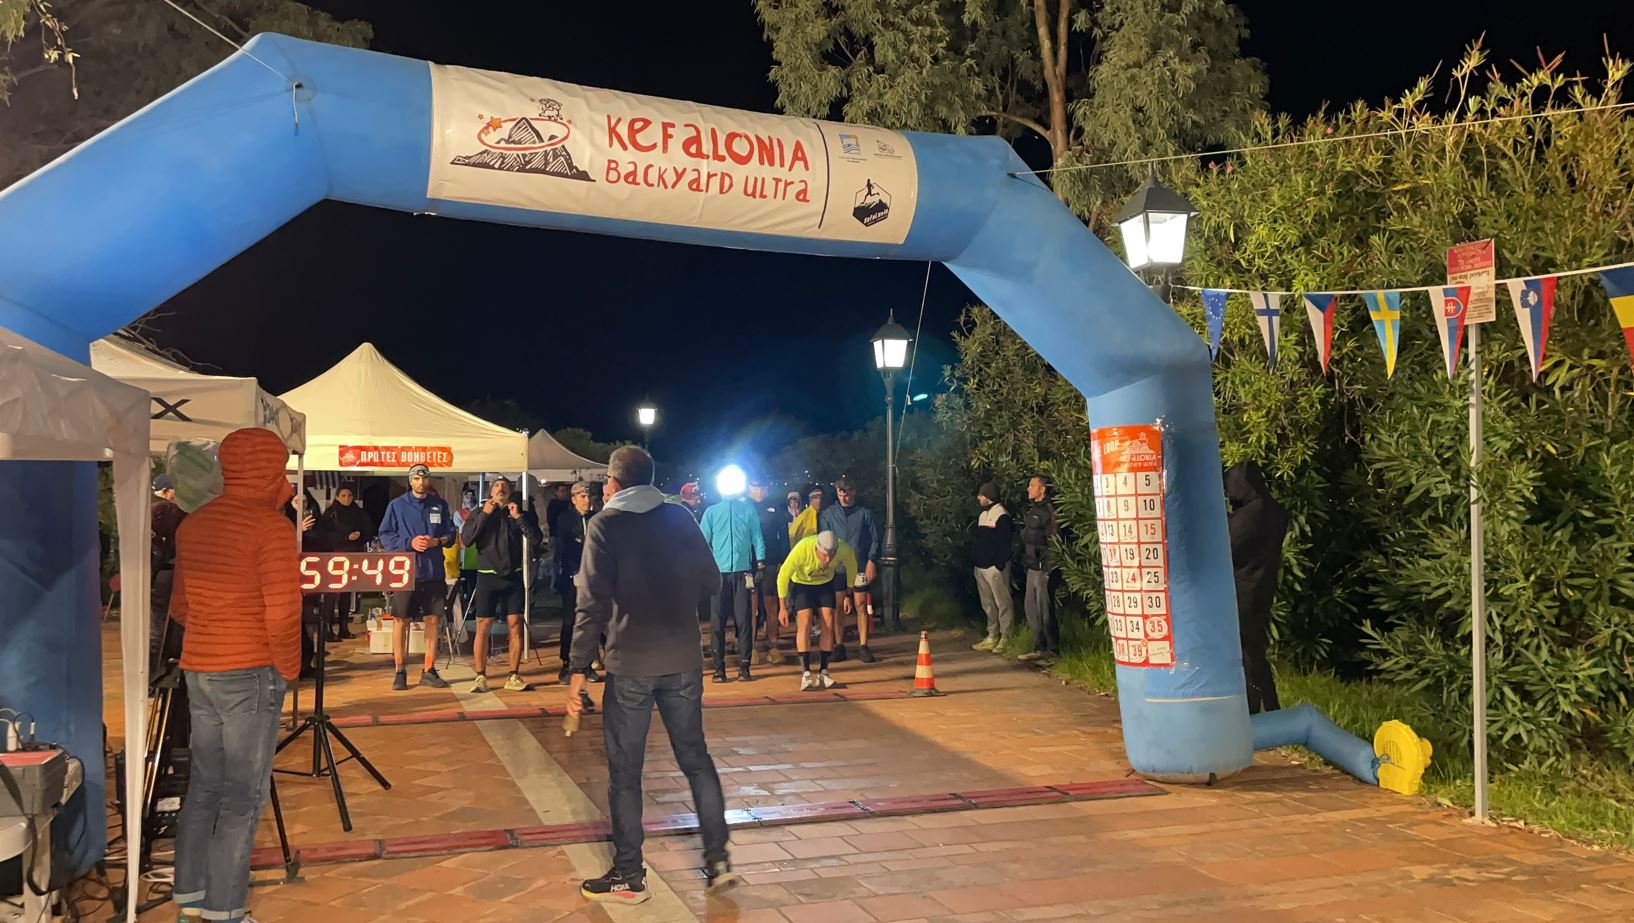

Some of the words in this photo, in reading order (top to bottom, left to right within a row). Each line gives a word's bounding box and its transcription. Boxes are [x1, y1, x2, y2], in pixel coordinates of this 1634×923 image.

[1103, 439, 1120, 455] LOOP
[360, 451, 397, 463] ΠΡΩΤΕΣ
[1105, 476, 1110, 488] 3
[1122, 475, 1128, 487] 4
[1145, 474, 1151, 487] 5
[1123, 500, 1129, 512] 9
[1143, 499, 1155, 511] 10
[1108, 524, 1114, 537] 13
[1123, 523, 1133, 537] 14
[1144, 523, 1156, 536] 15
[1124, 548, 1135, 560] 19
[1145, 547, 1159, 560] 20
[299, 556, 410, 589] 59:49
[1111, 571, 1119, 584] 23
[1126, 572, 1137, 584] 24
[1146, 571, 1160, 584] 25
[1113, 595, 1121, 608] 28
[1127, 596, 1138, 608] 29
[1147, 595, 1161, 609] 30
[1115, 619, 1123, 632] 33
[1130, 620, 1140, 633] 34
[1149, 620, 1163, 633] 35
[1132, 644, 1143, 657] 39
[610, 883, 630, 892] HOKA
